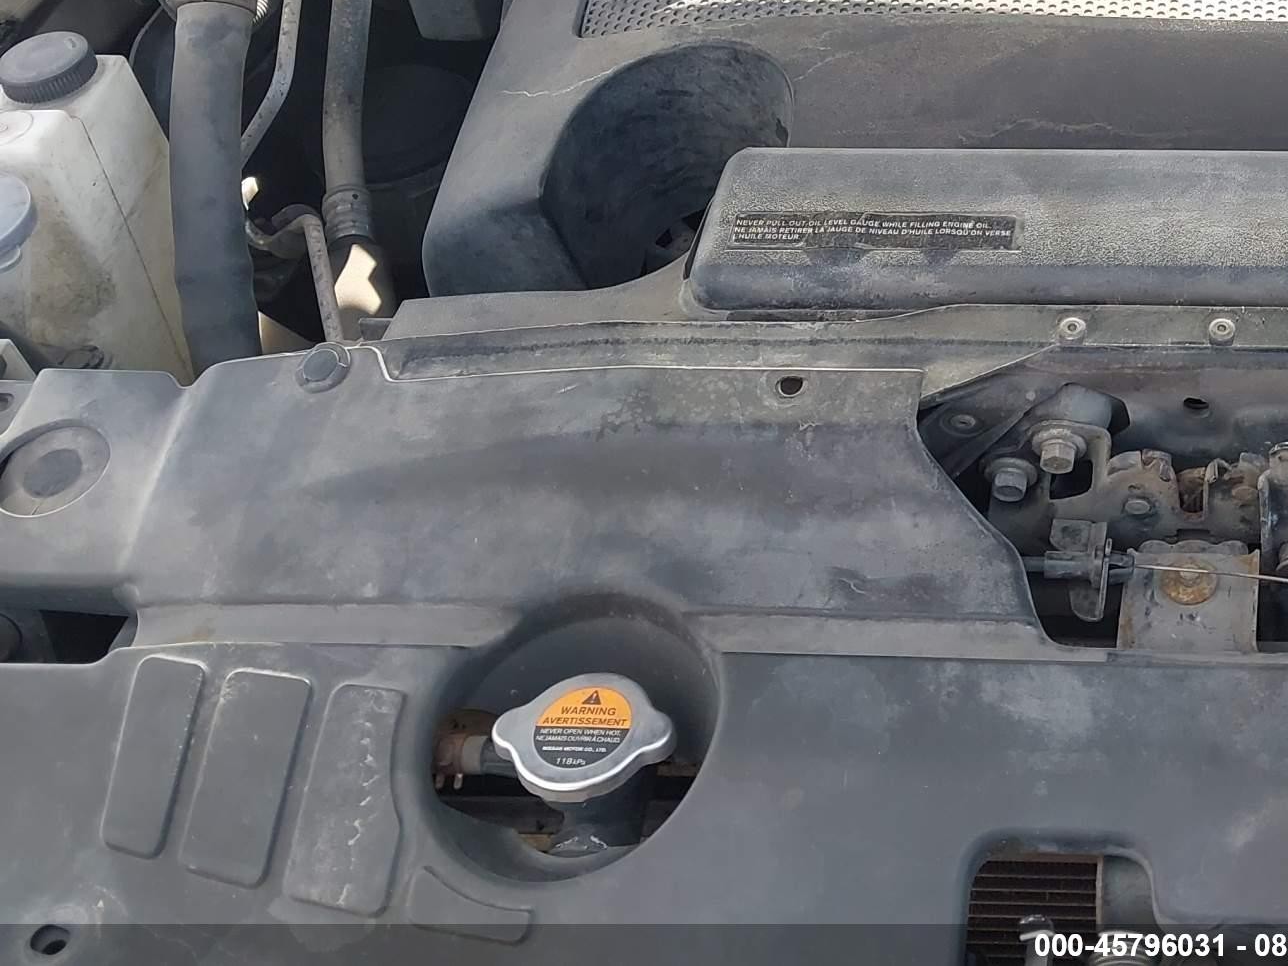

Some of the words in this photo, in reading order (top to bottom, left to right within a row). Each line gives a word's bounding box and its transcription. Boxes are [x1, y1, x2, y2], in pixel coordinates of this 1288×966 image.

[850, 219, 880, 227] GAUGE
[935, 228, 982, 236] LORSQU'ON
[561, 706, 617, 716] WARNING
[542, 716, 628, 726] AVERTISSEMENT
